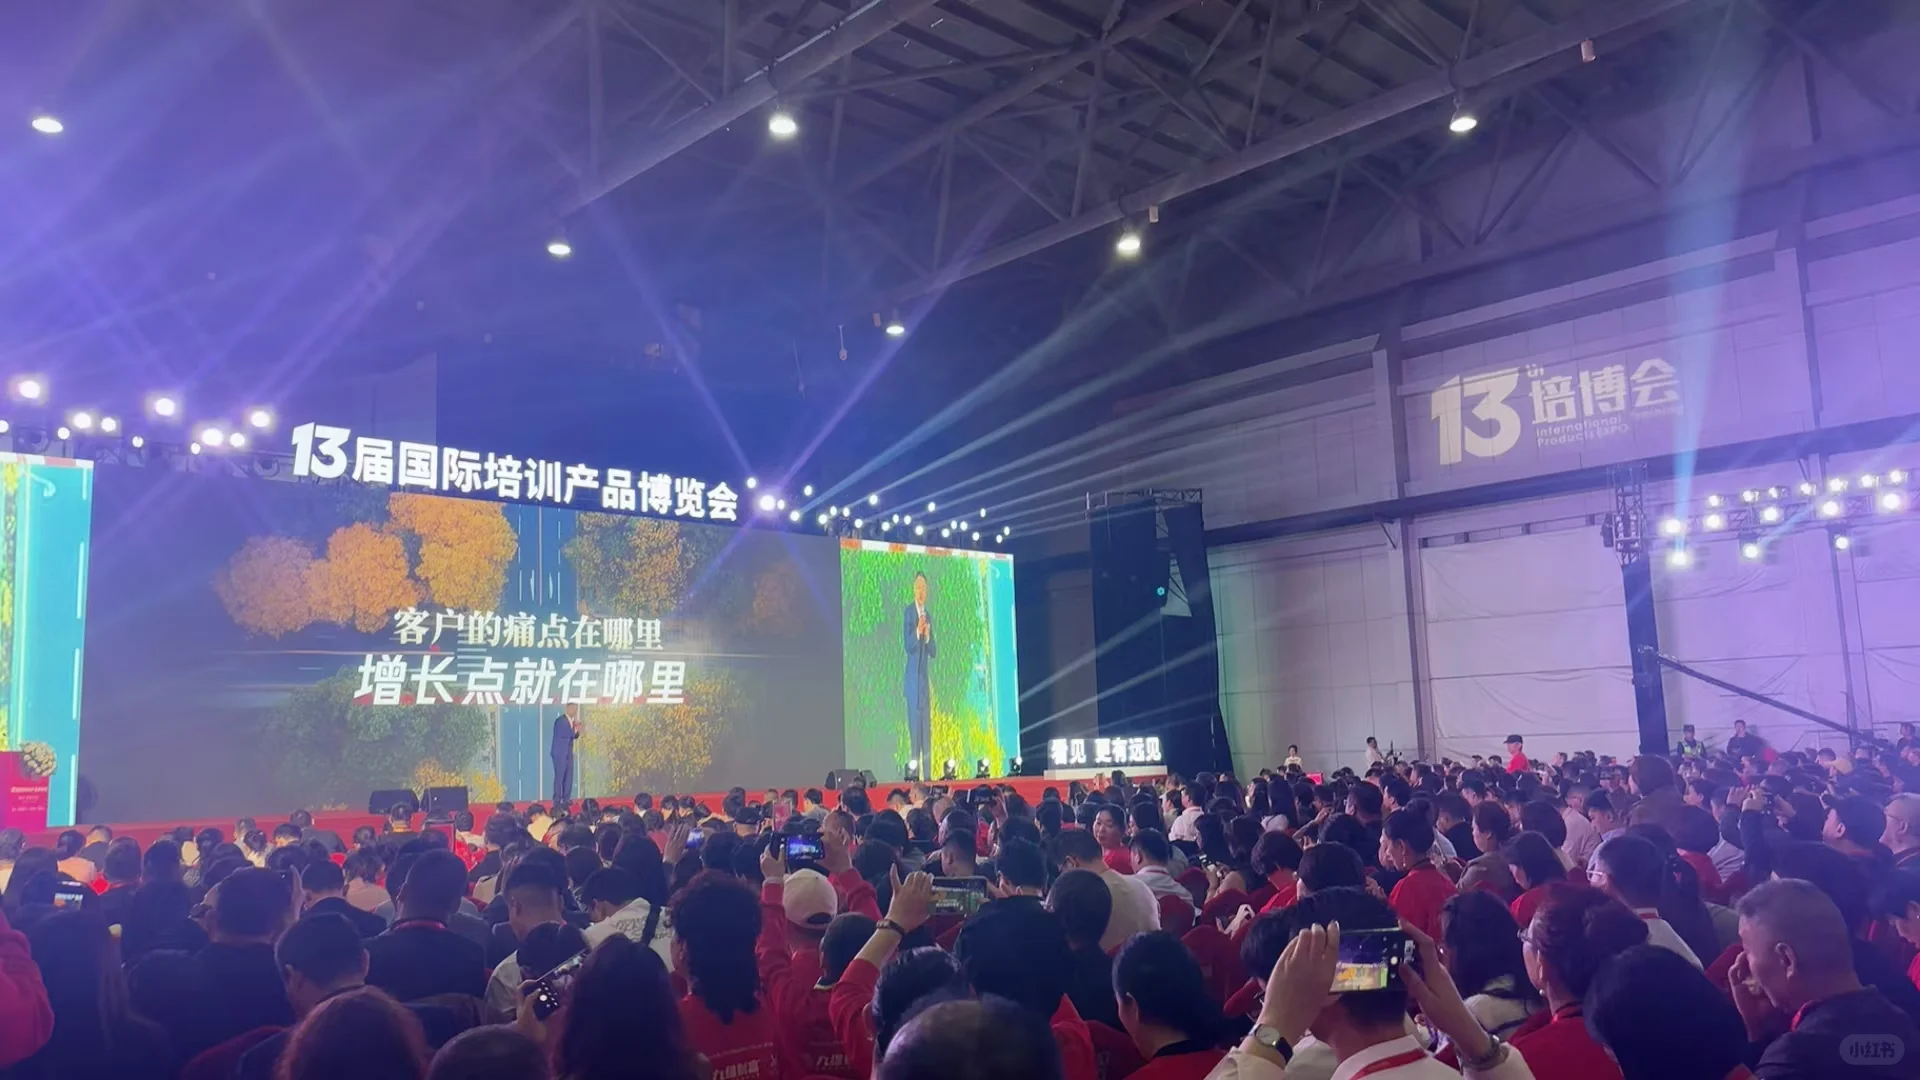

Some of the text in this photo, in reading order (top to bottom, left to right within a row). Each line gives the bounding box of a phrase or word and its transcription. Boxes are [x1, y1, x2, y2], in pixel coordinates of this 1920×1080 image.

[1529, 358, 1680, 424] 培博会
[1536, 415, 1622, 438] International
[291, 421, 739, 522] 13届国际培训产品博览会
[394, 606, 663, 651] 客户的痛点在哪里
[353, 653, 686, 705] 增长点就在哪里
[1051, 736, 1162, 765] 看见 更有远见
